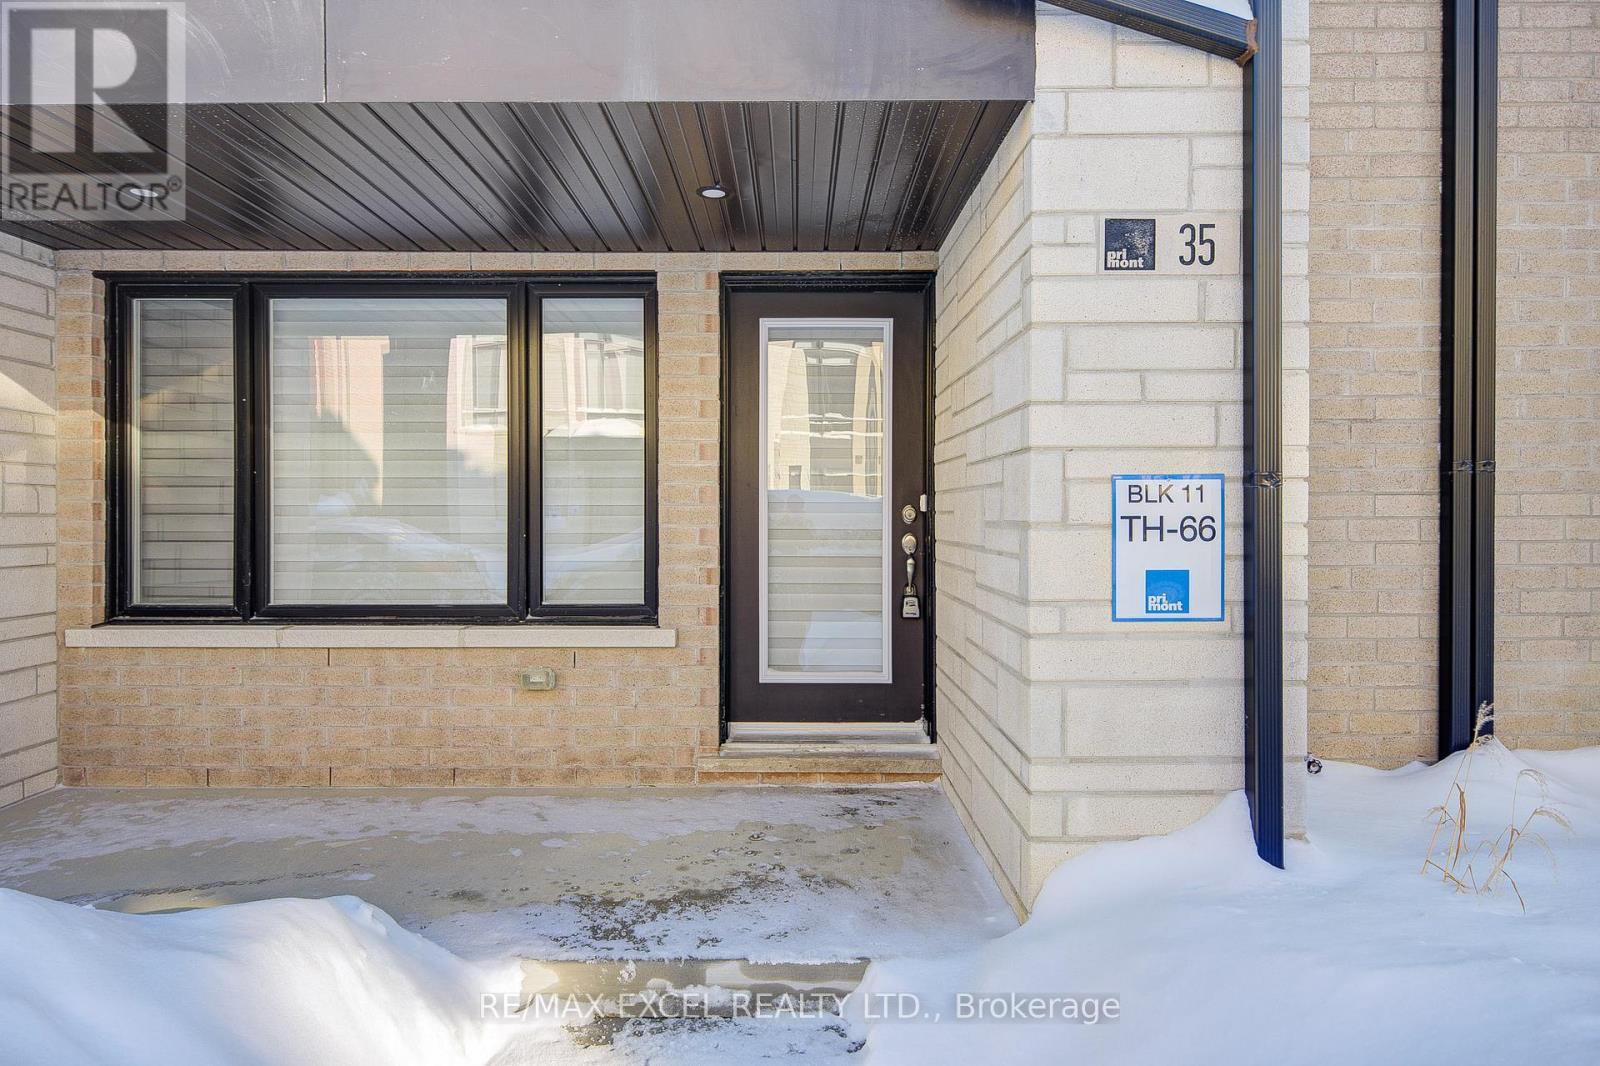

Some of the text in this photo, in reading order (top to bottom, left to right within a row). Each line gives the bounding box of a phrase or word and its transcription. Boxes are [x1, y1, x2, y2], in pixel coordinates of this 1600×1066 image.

[1178, 223, 1216, 266] 35
[1106, 248, 1127, 261] pri
[1106, 257, 1144, 268] mont
[1128, 484, 1204, 503] BLK 11
[1120, 515, 1217, 542] TH-66
[1148, 593, 1167, 605] pri
[1148, 601, 1183, 611] mont
